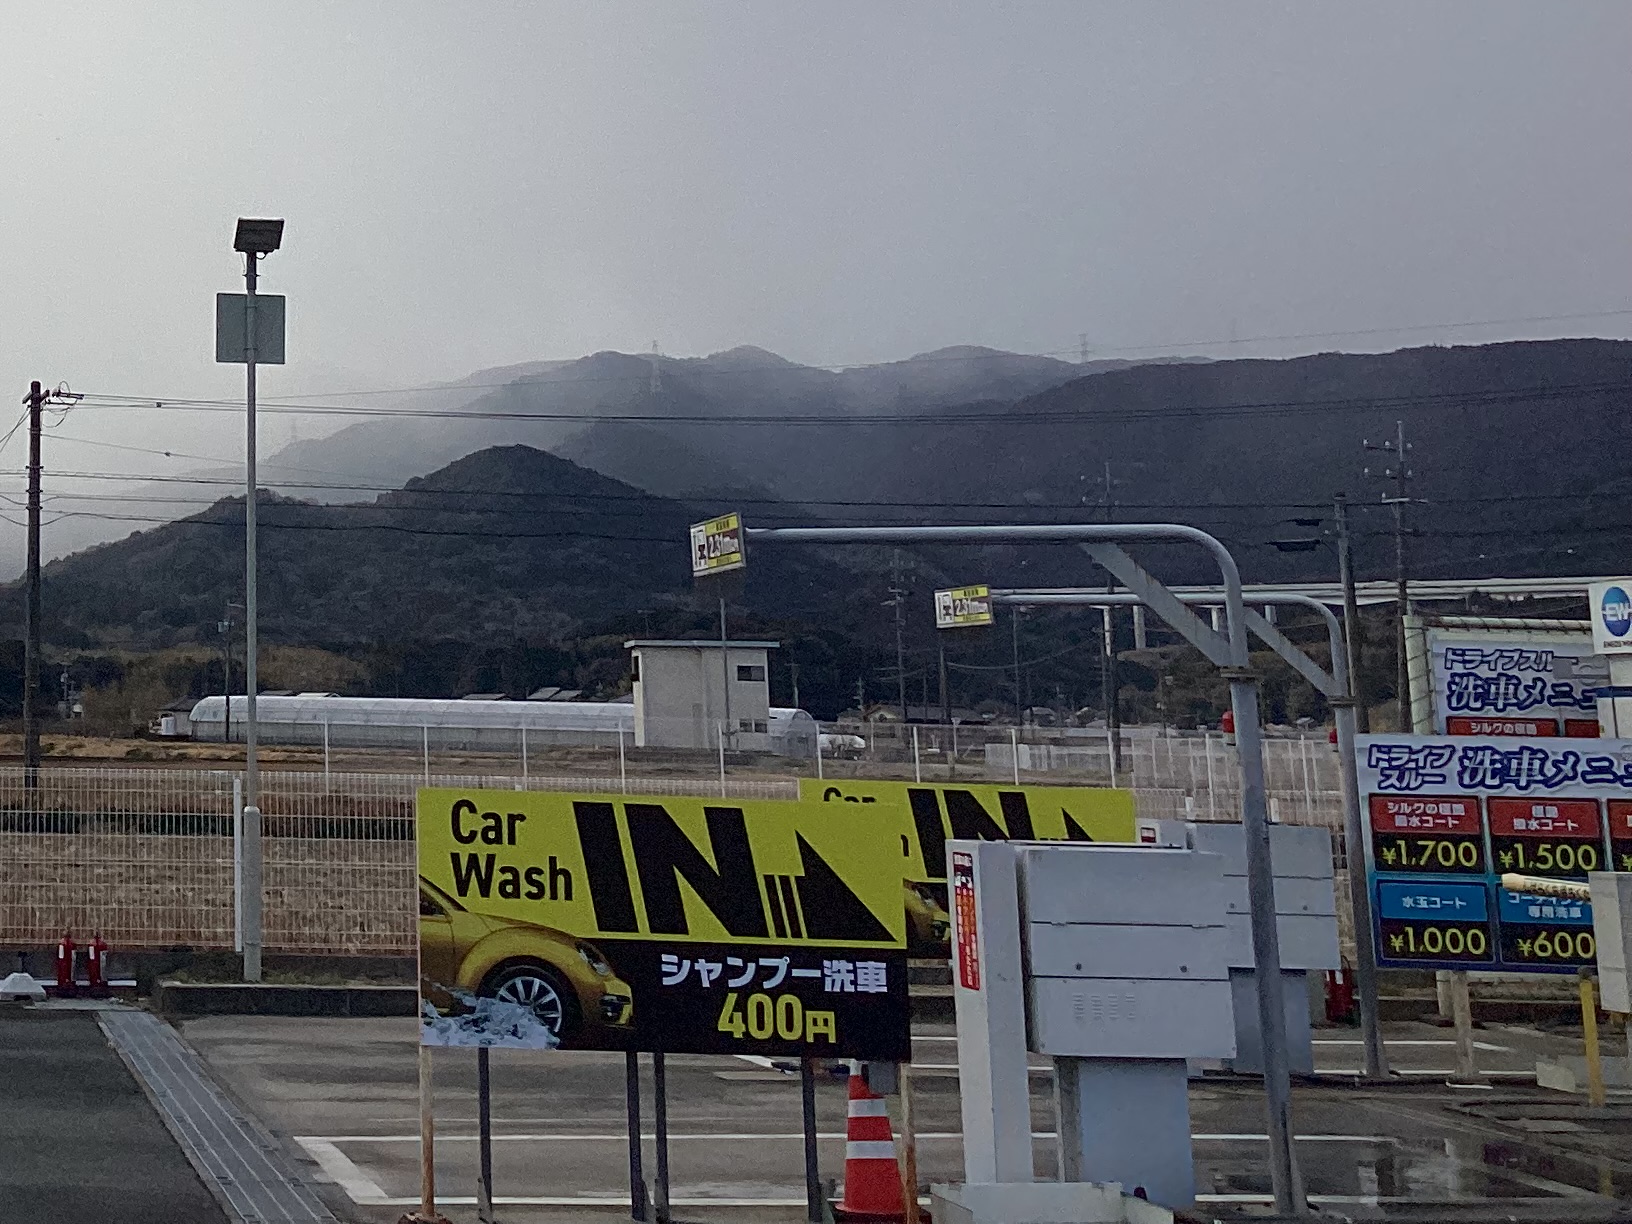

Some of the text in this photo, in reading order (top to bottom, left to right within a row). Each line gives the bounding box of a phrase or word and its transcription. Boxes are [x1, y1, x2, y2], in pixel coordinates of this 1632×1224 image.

[1368, 743, 1455, 769] ドライブ
[1377, 767, 1447, 790] スルー
[451, 799, 527, 846] Car
[1382, 839, 1478, 867] ¥1,700
[1499, 842, 1597, 871] ¥1,500
[451, 853, 573, 903] Wash
[1390, 926, 1486, 955] ¥1,000
[661, 953, 888, 994] シャンプー洗車
[717, 992, 837, 1044] 400円
